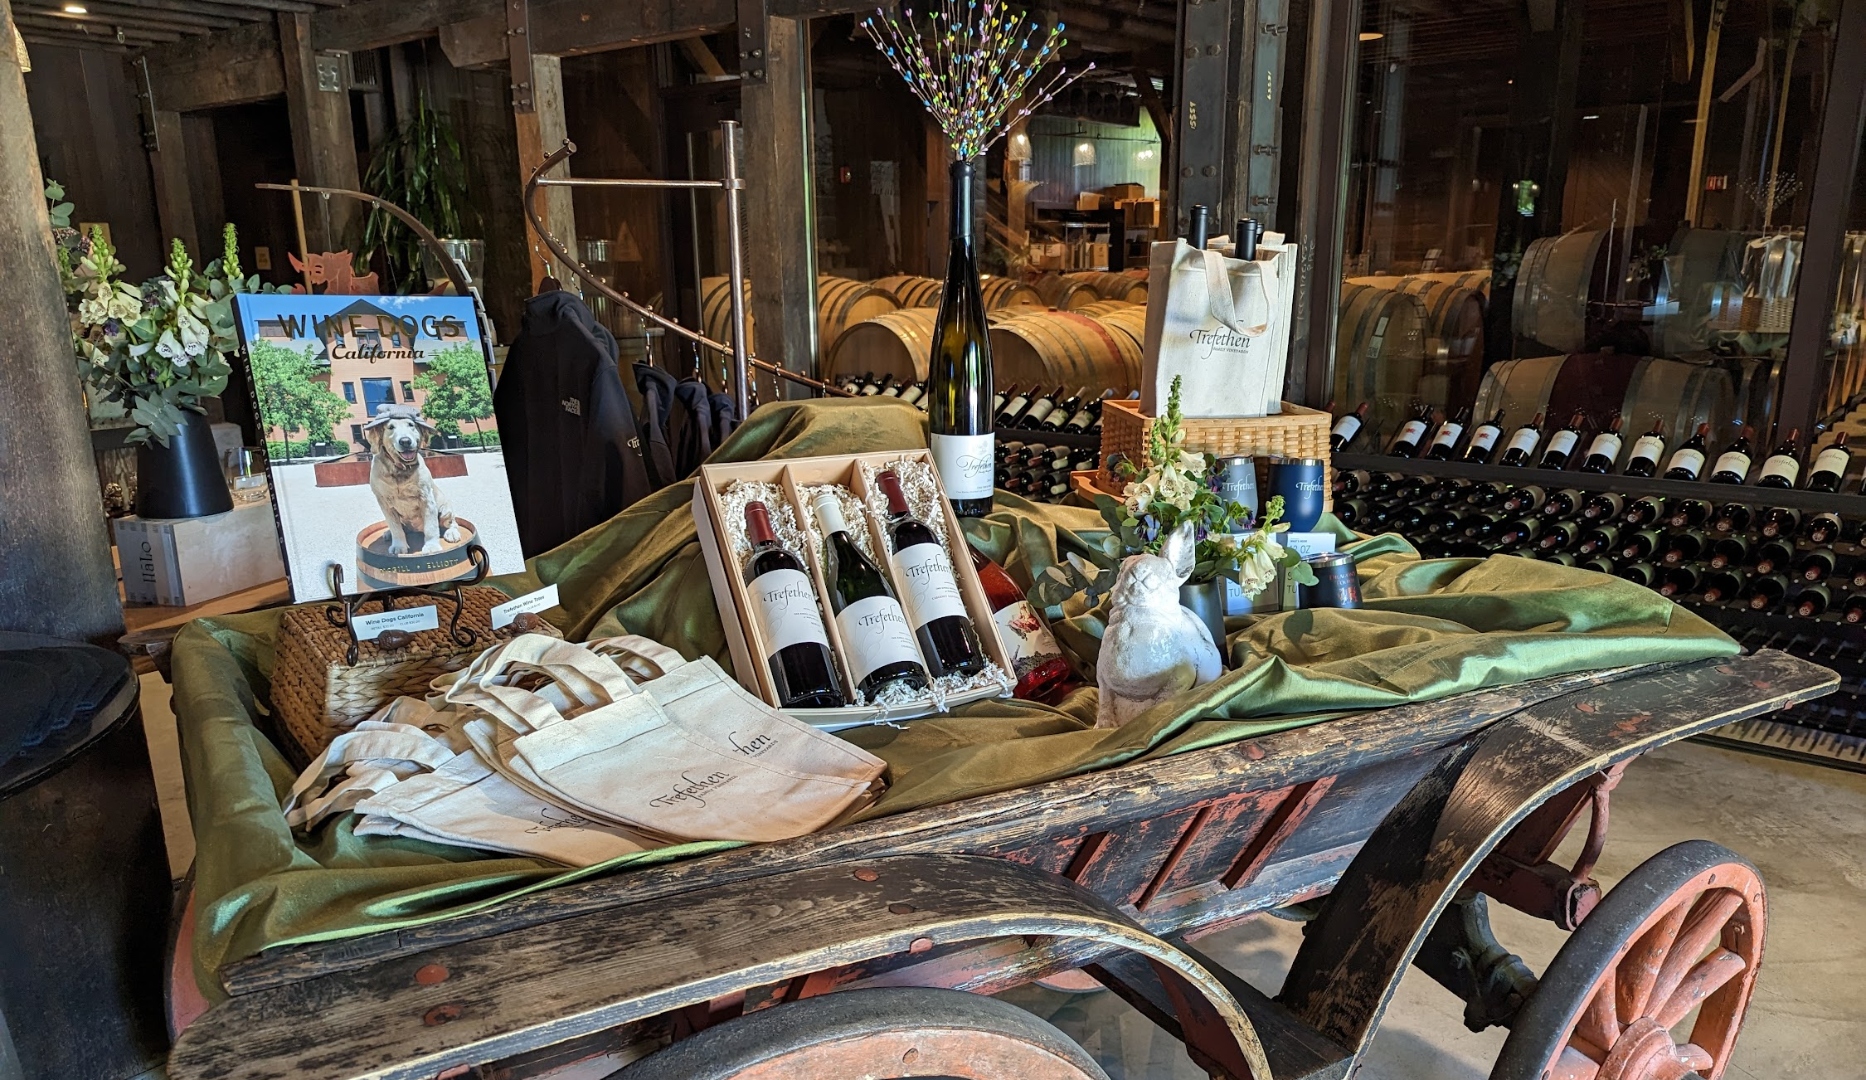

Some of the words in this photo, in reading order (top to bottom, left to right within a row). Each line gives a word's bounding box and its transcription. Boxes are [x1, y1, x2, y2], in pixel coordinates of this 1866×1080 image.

[277, 314, 362, 338] WINE
[376, 314, 460, 338] DOGS
[332, 343, 424, 364] California
[1189, 326, 1251, 360] Trefethen
[241, 344, 252, 383] WINE
[250, 390, 261, 430] DOGS
[260, 438, 281, 528] CALIFORNIA
[1300, 545, 1311, 554] OZ
[426, 558, 459, 569] ELLIOTT
[763, 580, 814, 611] Trefethen
[397, 612, 425, 621] California
[649, 770, 730, 809] Trefethen
